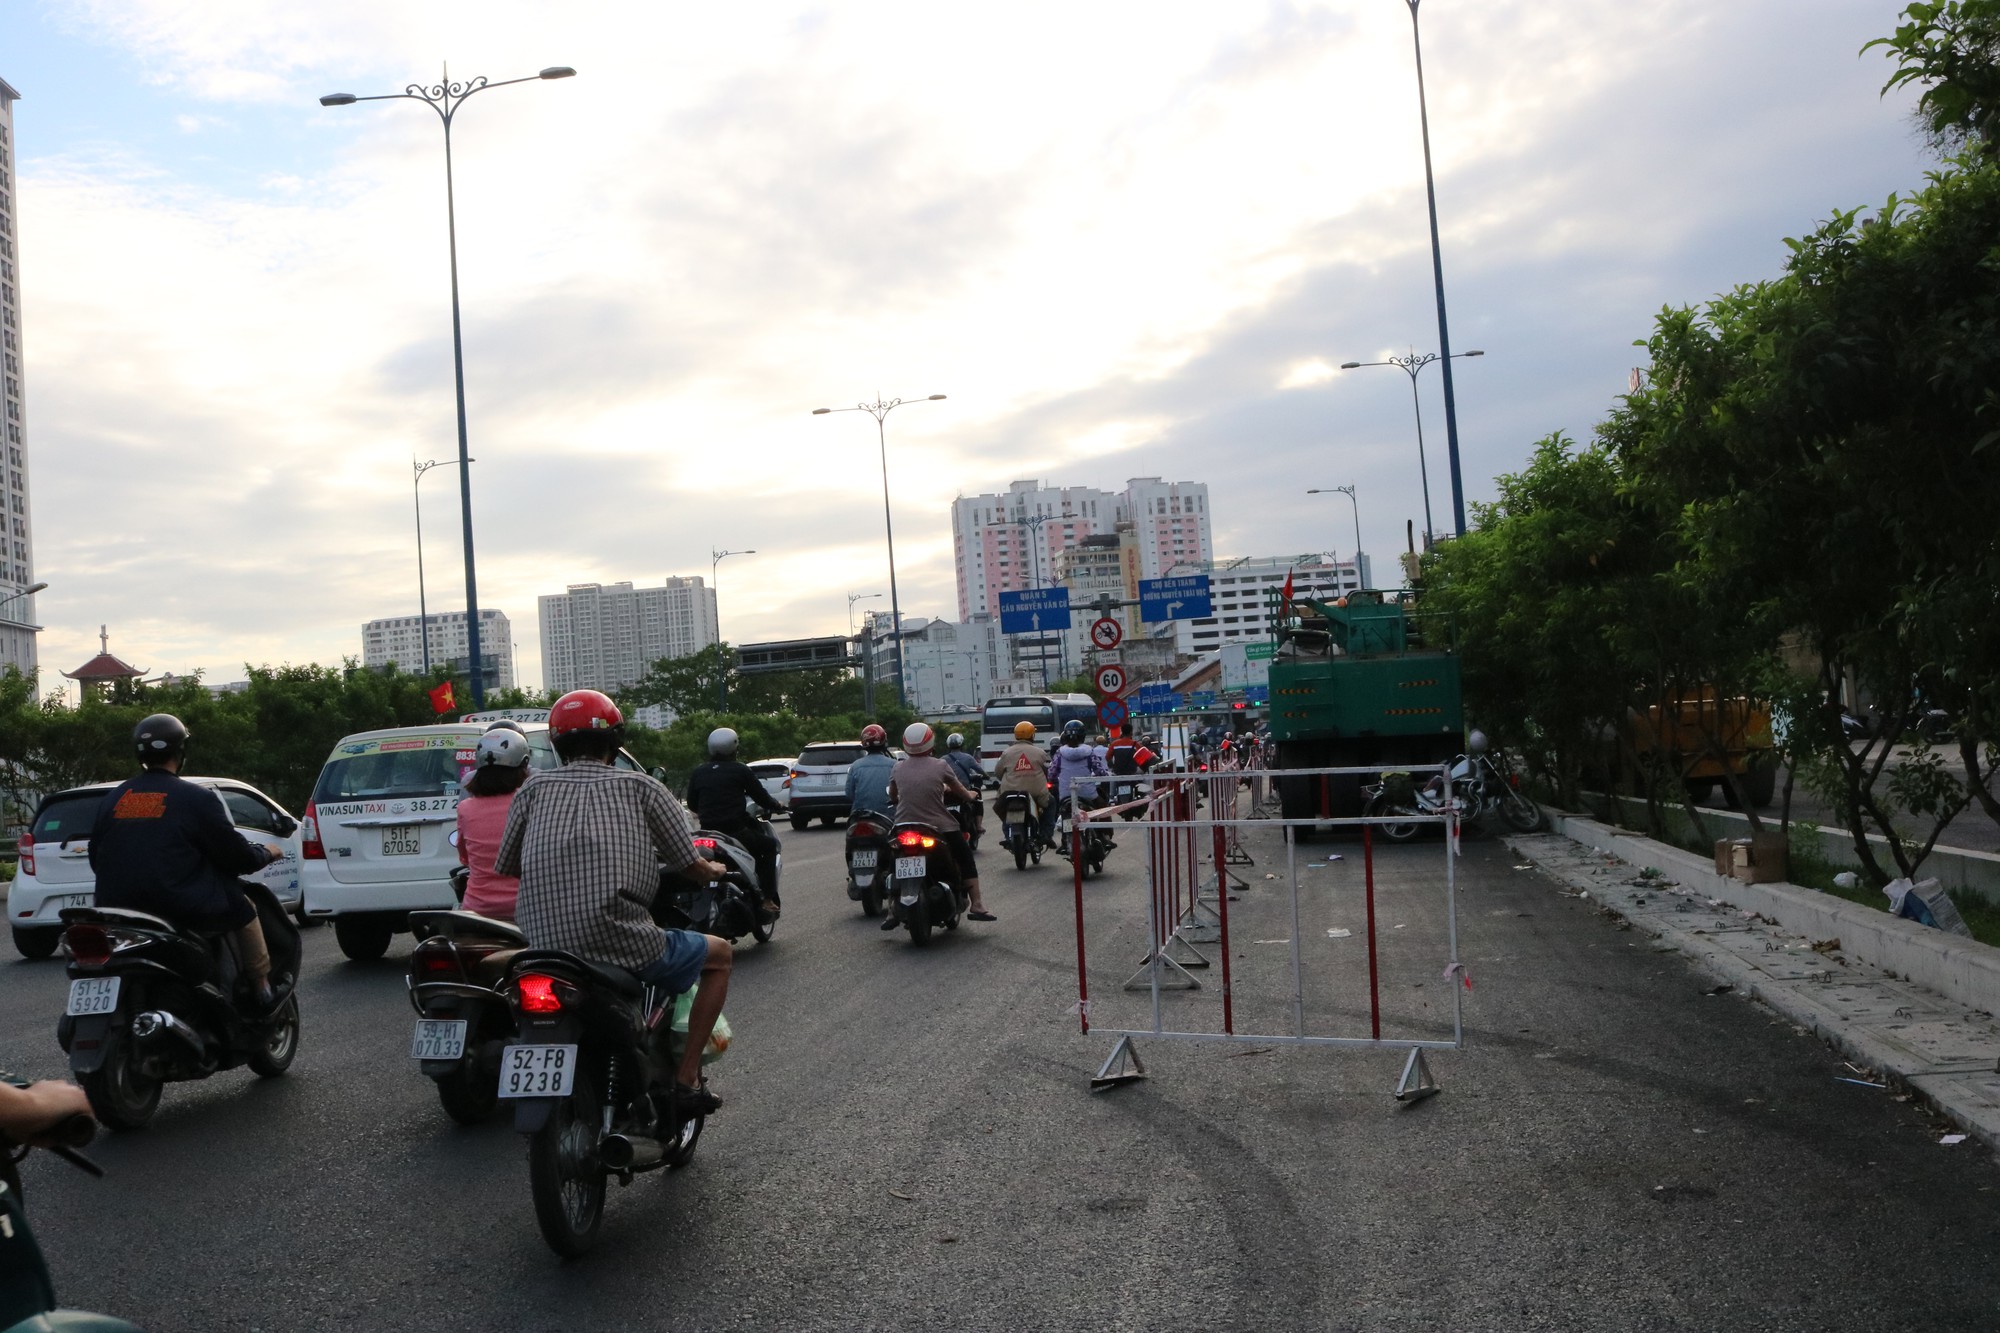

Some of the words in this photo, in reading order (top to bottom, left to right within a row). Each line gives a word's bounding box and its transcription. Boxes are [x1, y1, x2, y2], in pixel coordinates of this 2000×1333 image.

[1041, 590, 1047, 598] 5
[1103, 673, 1119, 687] 60
[533, 713, 548, 722] 27
[426, 740, 454, 748] 15.5%
[411, 800, 448, 812] 38.27
[391, 828, 410, 840] 51F
[384, 840, 418, 854] 670.52
[70, 896, 86, 907] 74A
[78, 980, 111, 996] 51-L4
[75, 996, 109, 1012] 5920
[423, 1023, 457, 1039] 59-H1
[416, 1041, 461, 1056] 070.33
[513, 1049, 565, 1070] 52-F8
[509, 1071, 562, 1093] 9238
